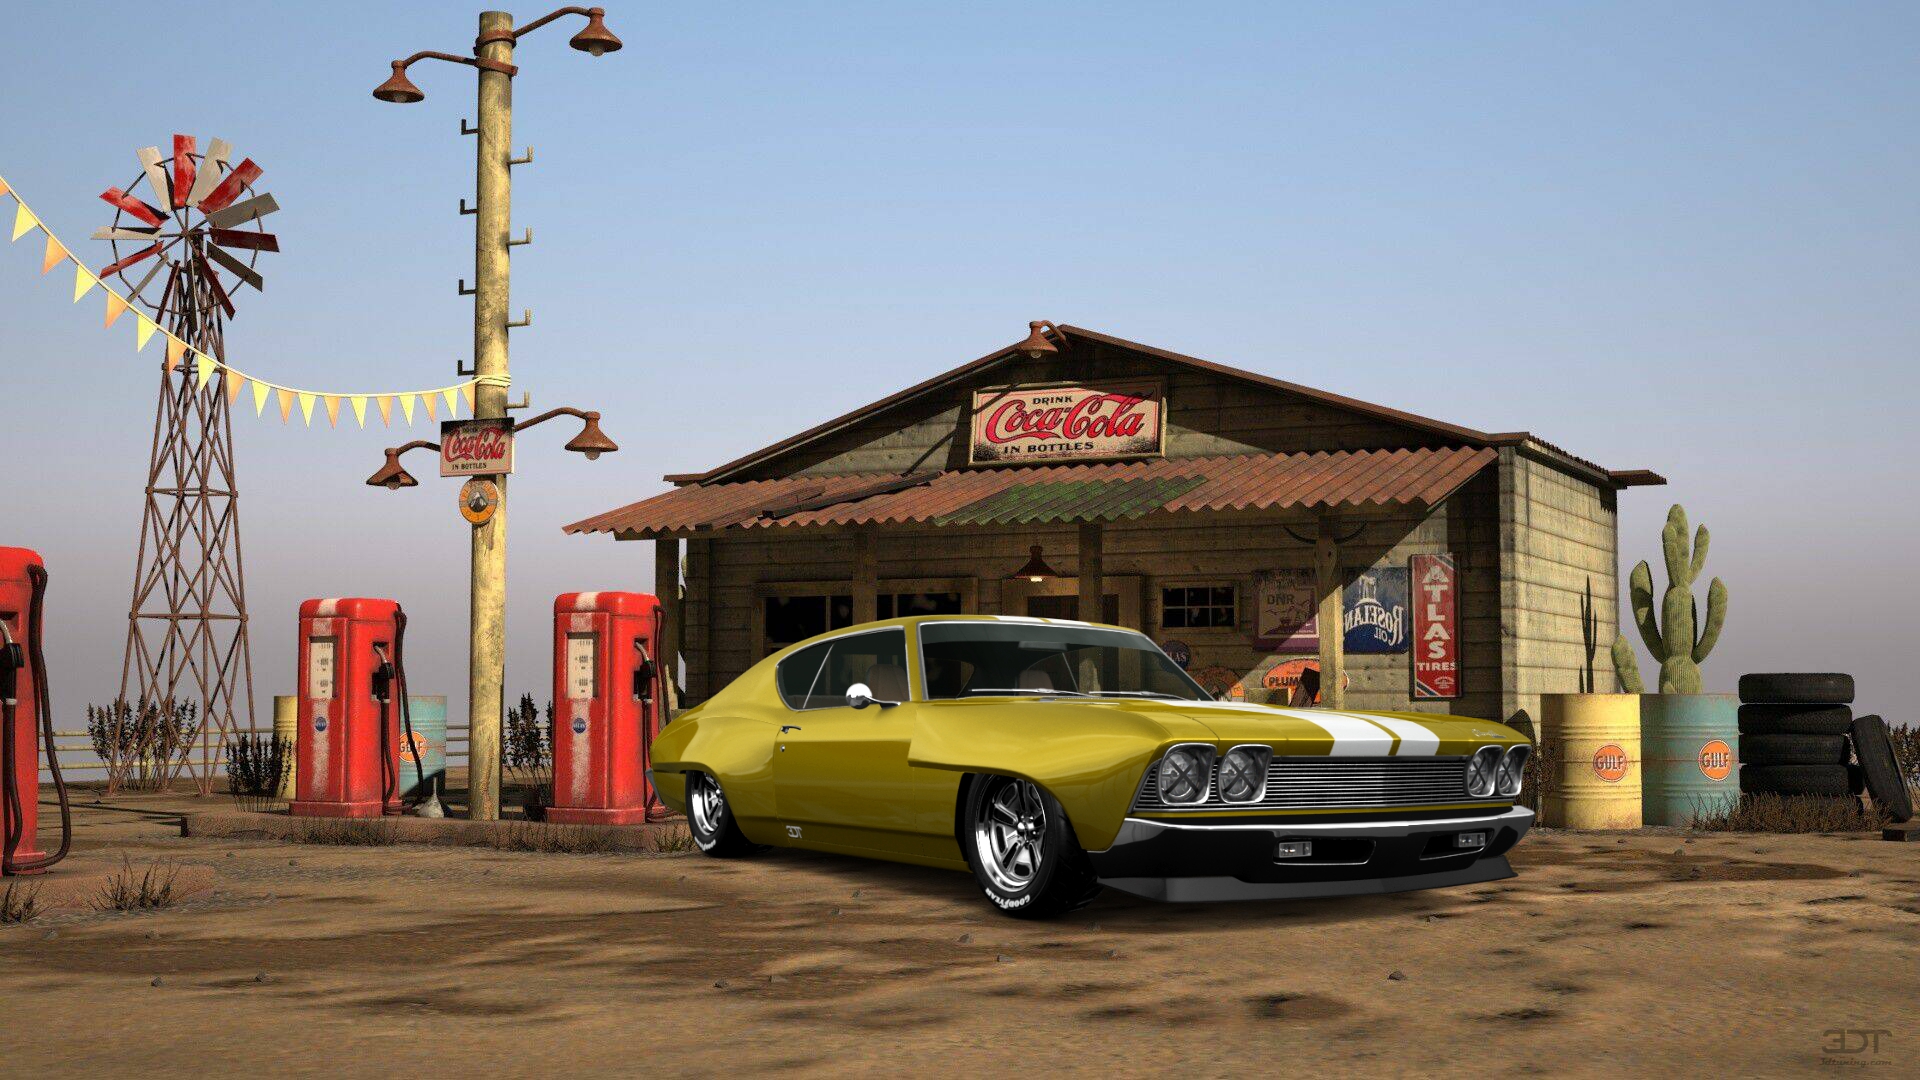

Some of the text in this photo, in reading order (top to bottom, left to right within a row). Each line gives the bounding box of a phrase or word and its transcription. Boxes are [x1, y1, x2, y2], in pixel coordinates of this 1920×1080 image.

[1032, 395, 1074, 406] DRINK
[985, 393, 1147, 444] Coca-Cola
[1003, 441, 1094, 454] IN BOTTLES
[1421, 565, 1451, 659] ATLAS
[1416, 661, 1457, 672] TIRES
[1595, 754, 1626, 771] GULF
[1700, 752, 1730, 768] GULF
